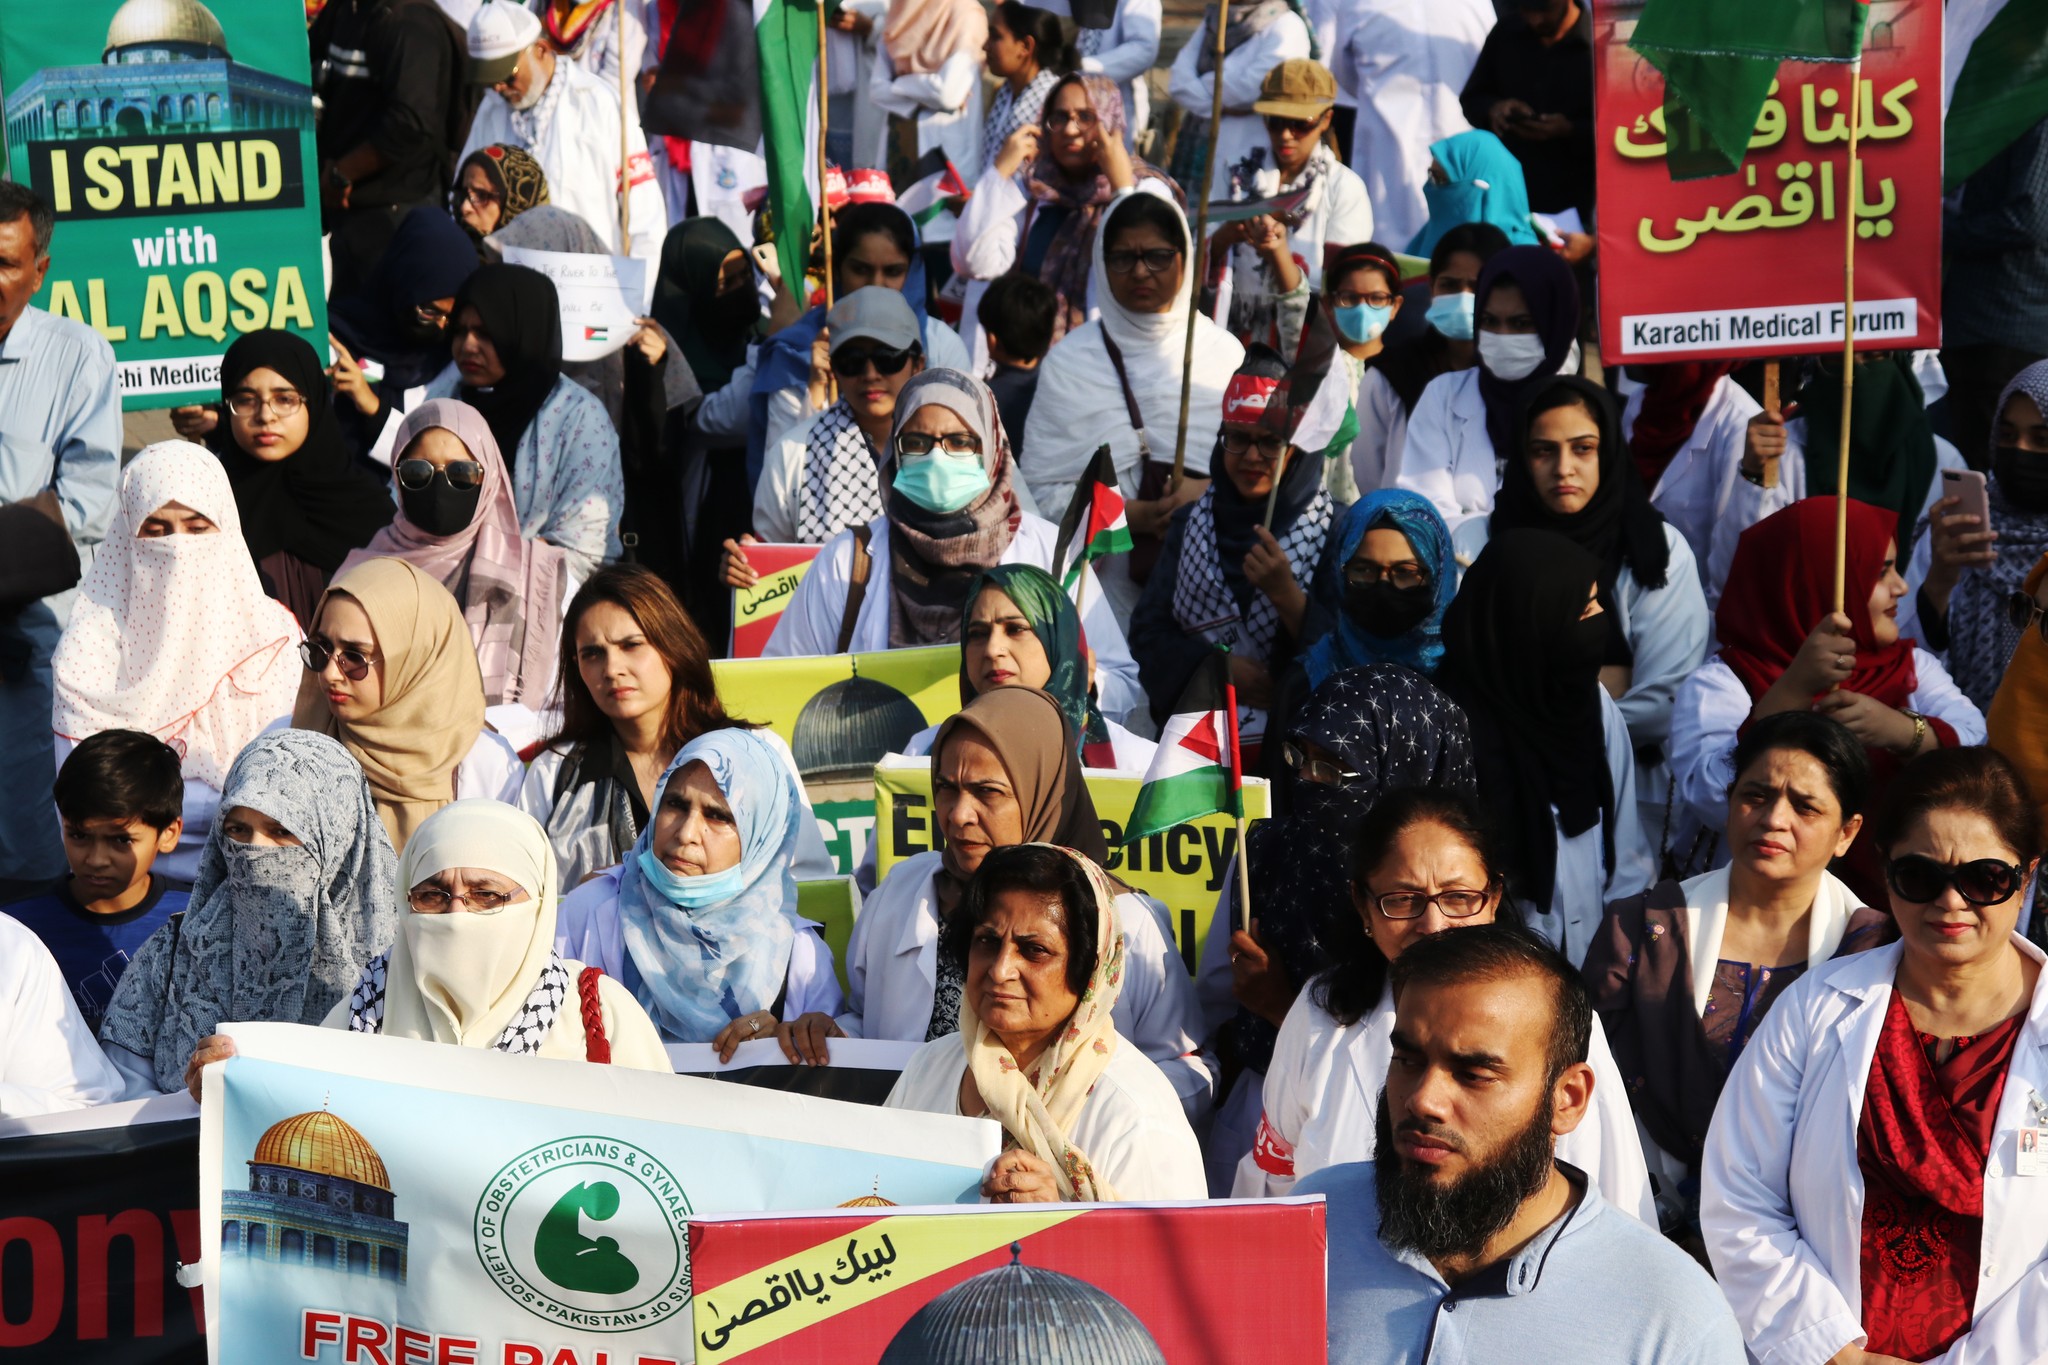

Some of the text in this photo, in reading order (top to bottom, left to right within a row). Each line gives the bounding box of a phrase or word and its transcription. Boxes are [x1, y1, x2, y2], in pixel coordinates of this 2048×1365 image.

[51, 139, 282, 212] I STAND
[132, 225, 218, 268] with
[48, 265, 315, 344] AL AQSA
[1633, 317, 1721, 346] Karachi
[1730, 310, 1821, 341] Medical
[486, 1142, 620, 1213] OBSTETRICIANS
[624, 1152, 637, 1167] &
[481, 1216, 496, 1238] OF
[483, 1243, 536, 1303] SOCIETY
[546, 1303, 638, 1327] PAKISTAN
[650, 1301, 671, 1319] OF
[303, 1311, 478, 1365] FREE
